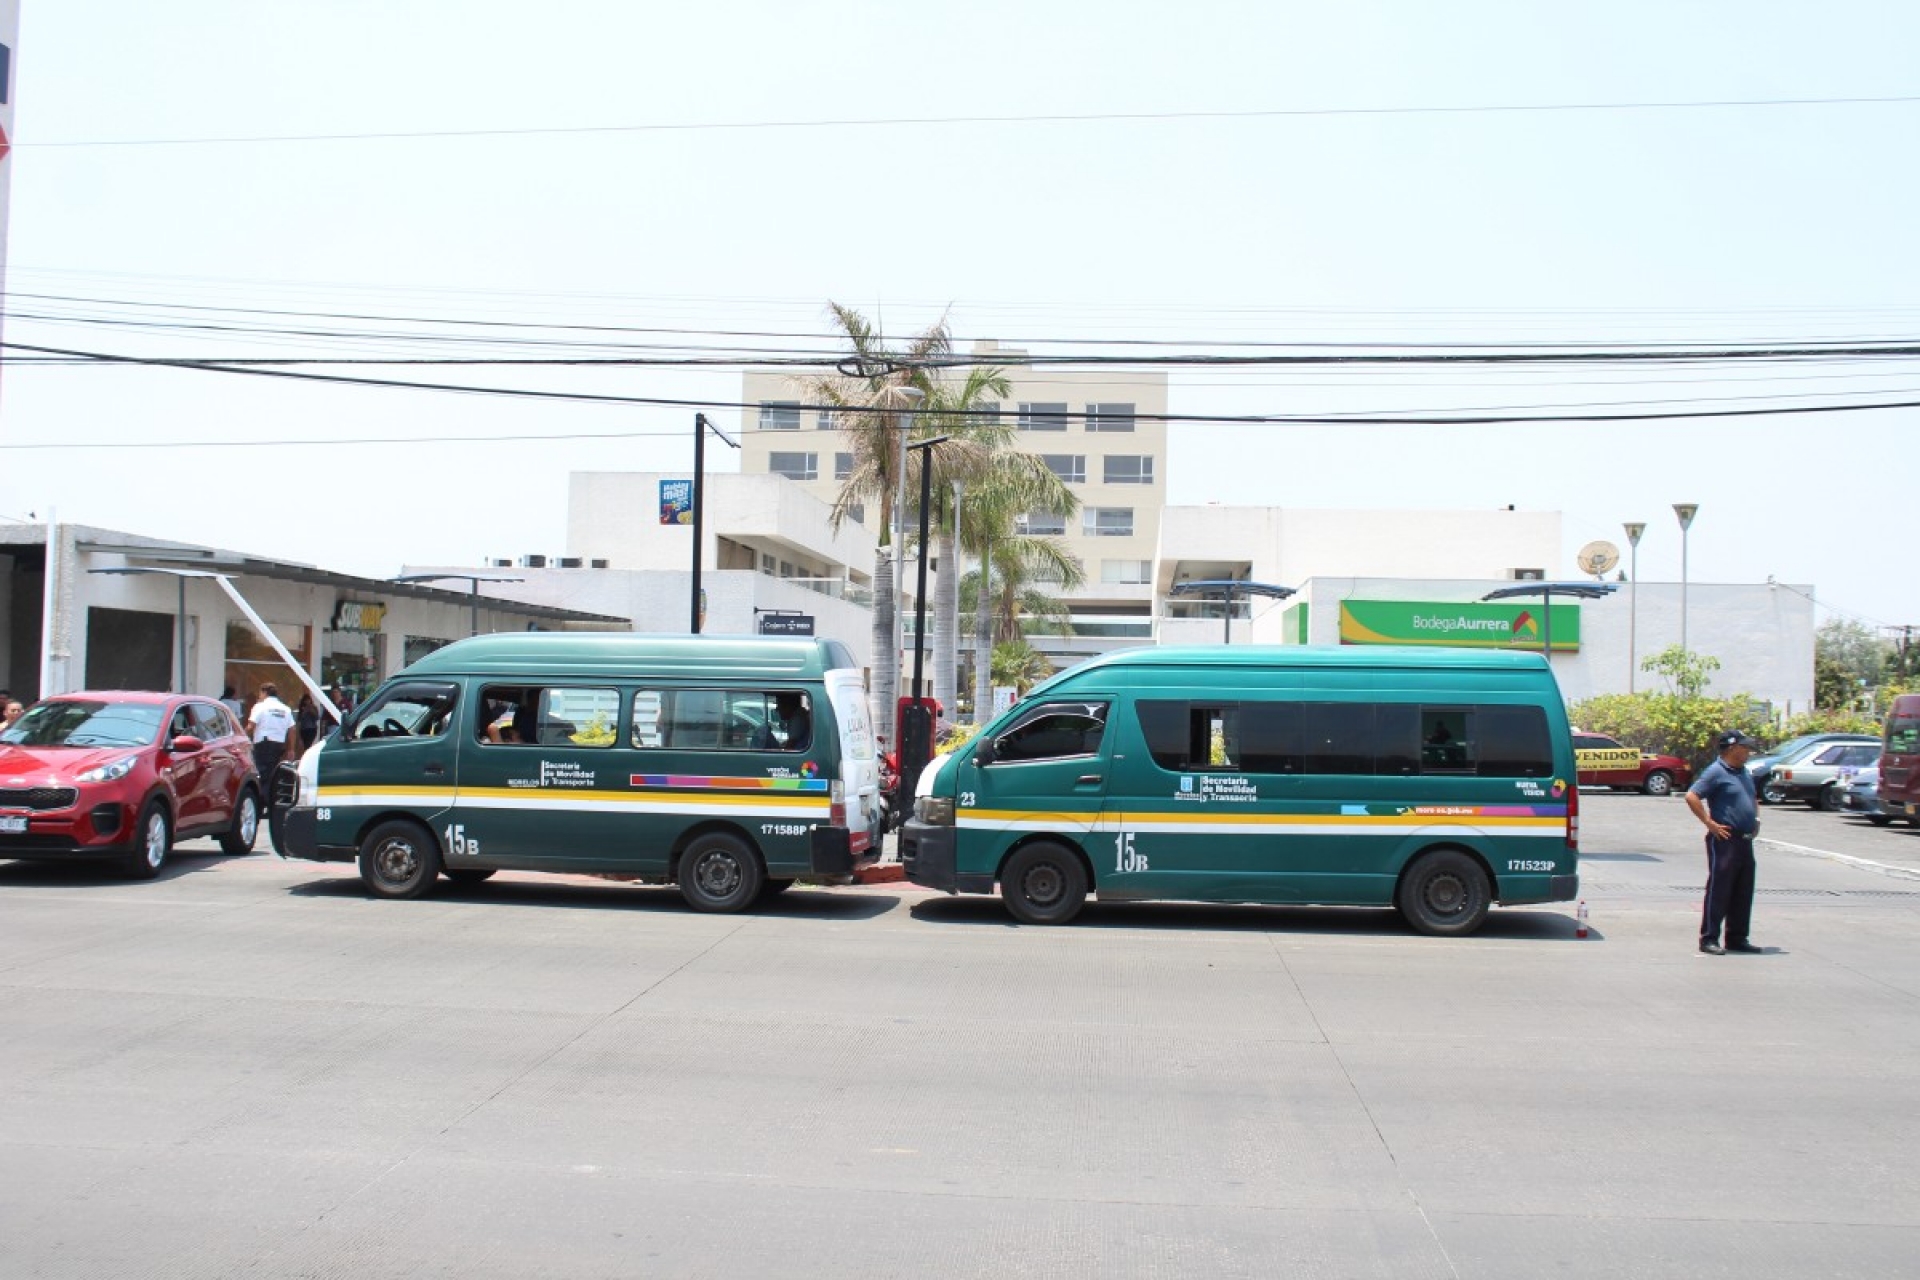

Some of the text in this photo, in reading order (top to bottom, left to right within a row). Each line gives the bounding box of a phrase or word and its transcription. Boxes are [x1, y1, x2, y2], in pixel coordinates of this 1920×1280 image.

[338, 603, 386, 629] SUBWAY
[552, 777, 594, 787] Transporte
[1216, 785, 1256, 793] Movilidad
[961, 792, 975, 806] 23
[1210, 794, 1256, 802] Transporte
[317, 807, 331, 820] 88
[760, 824, 807, 835] 171588P
[1507, 860, 1556, 871] 171523P
